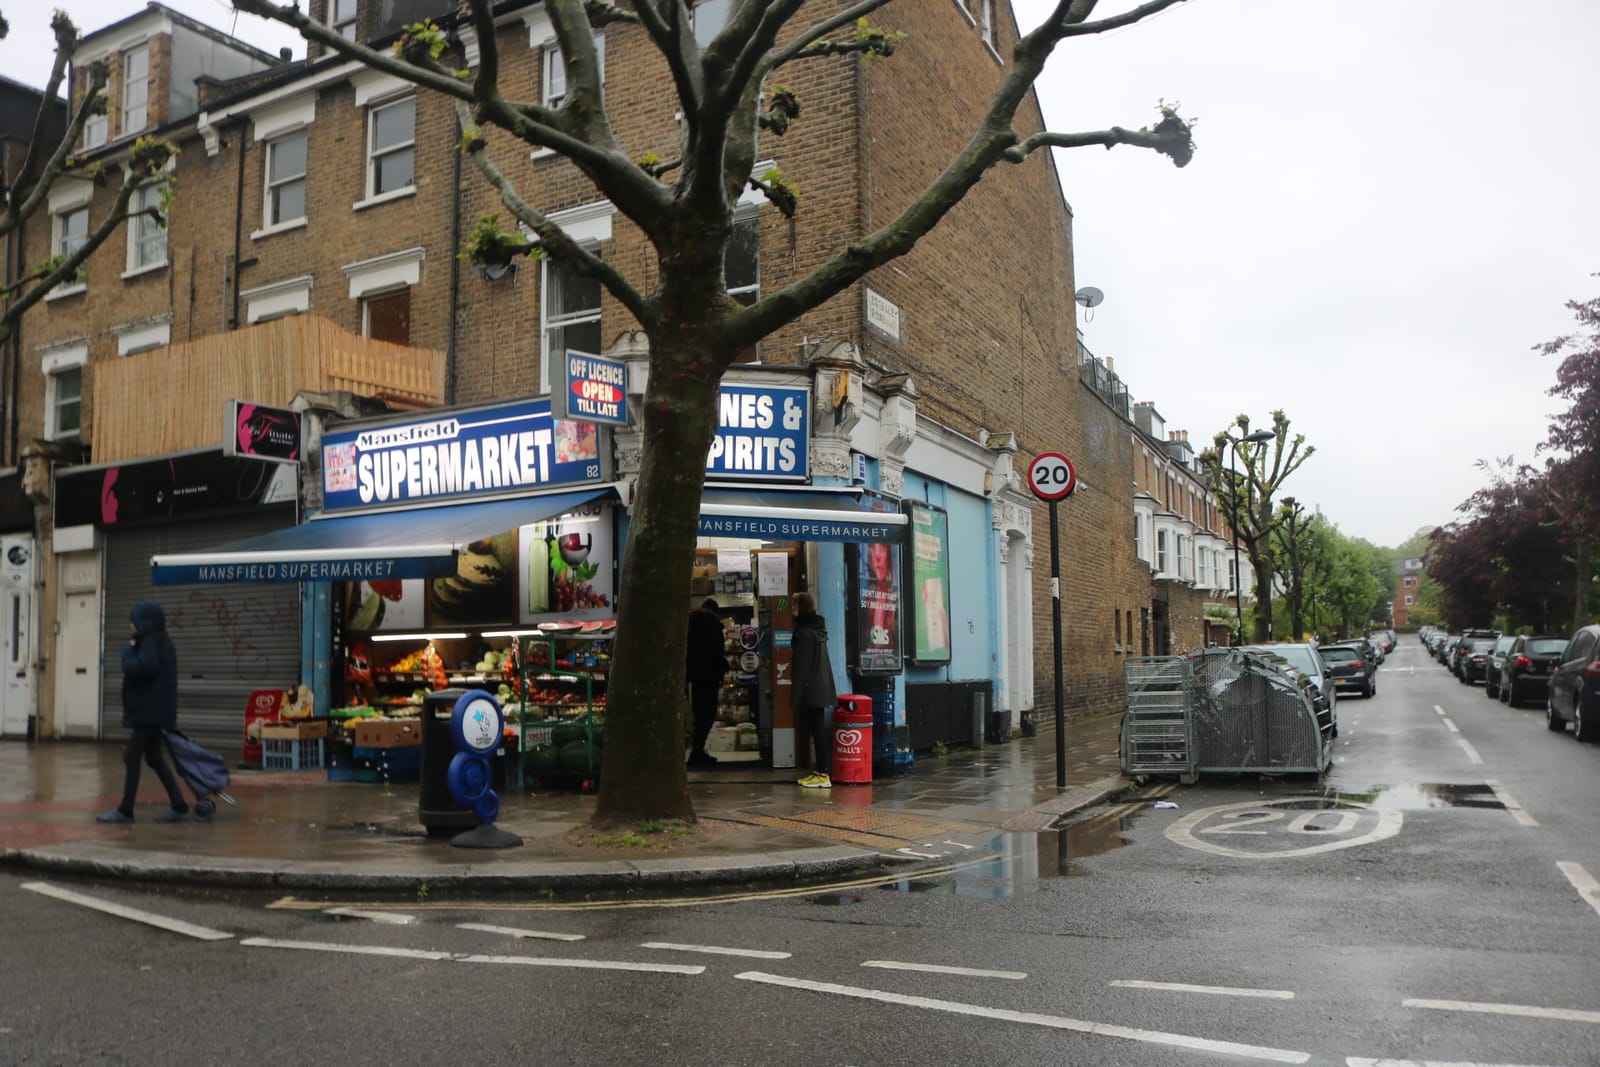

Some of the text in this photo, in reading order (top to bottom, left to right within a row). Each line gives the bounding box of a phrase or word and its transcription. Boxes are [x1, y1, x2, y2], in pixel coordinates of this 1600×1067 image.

[570, 358, 623, 385] OFF LICENCE
[582, 381, 613, 402] OPEN
[577, 399, 618, 417] TILL LATE
[719, 393, 802, 431] NES &
[360, 421, 456, 447] Mansfield
[706, 435, 796, 472] PIRITS
[358, 429, 552, 504] SUPERMARKET
[586, 465, 599, 478] 82
[1034, 466, 1070, 485] 20
[781, 524, 889, 537] SUPERMARKET
[199, 561, 395, 580] MANSFIELD SUPERMARKET
[836, 746, 861, 754] WALL'S
[1200, 810, 1361, 836] 20
